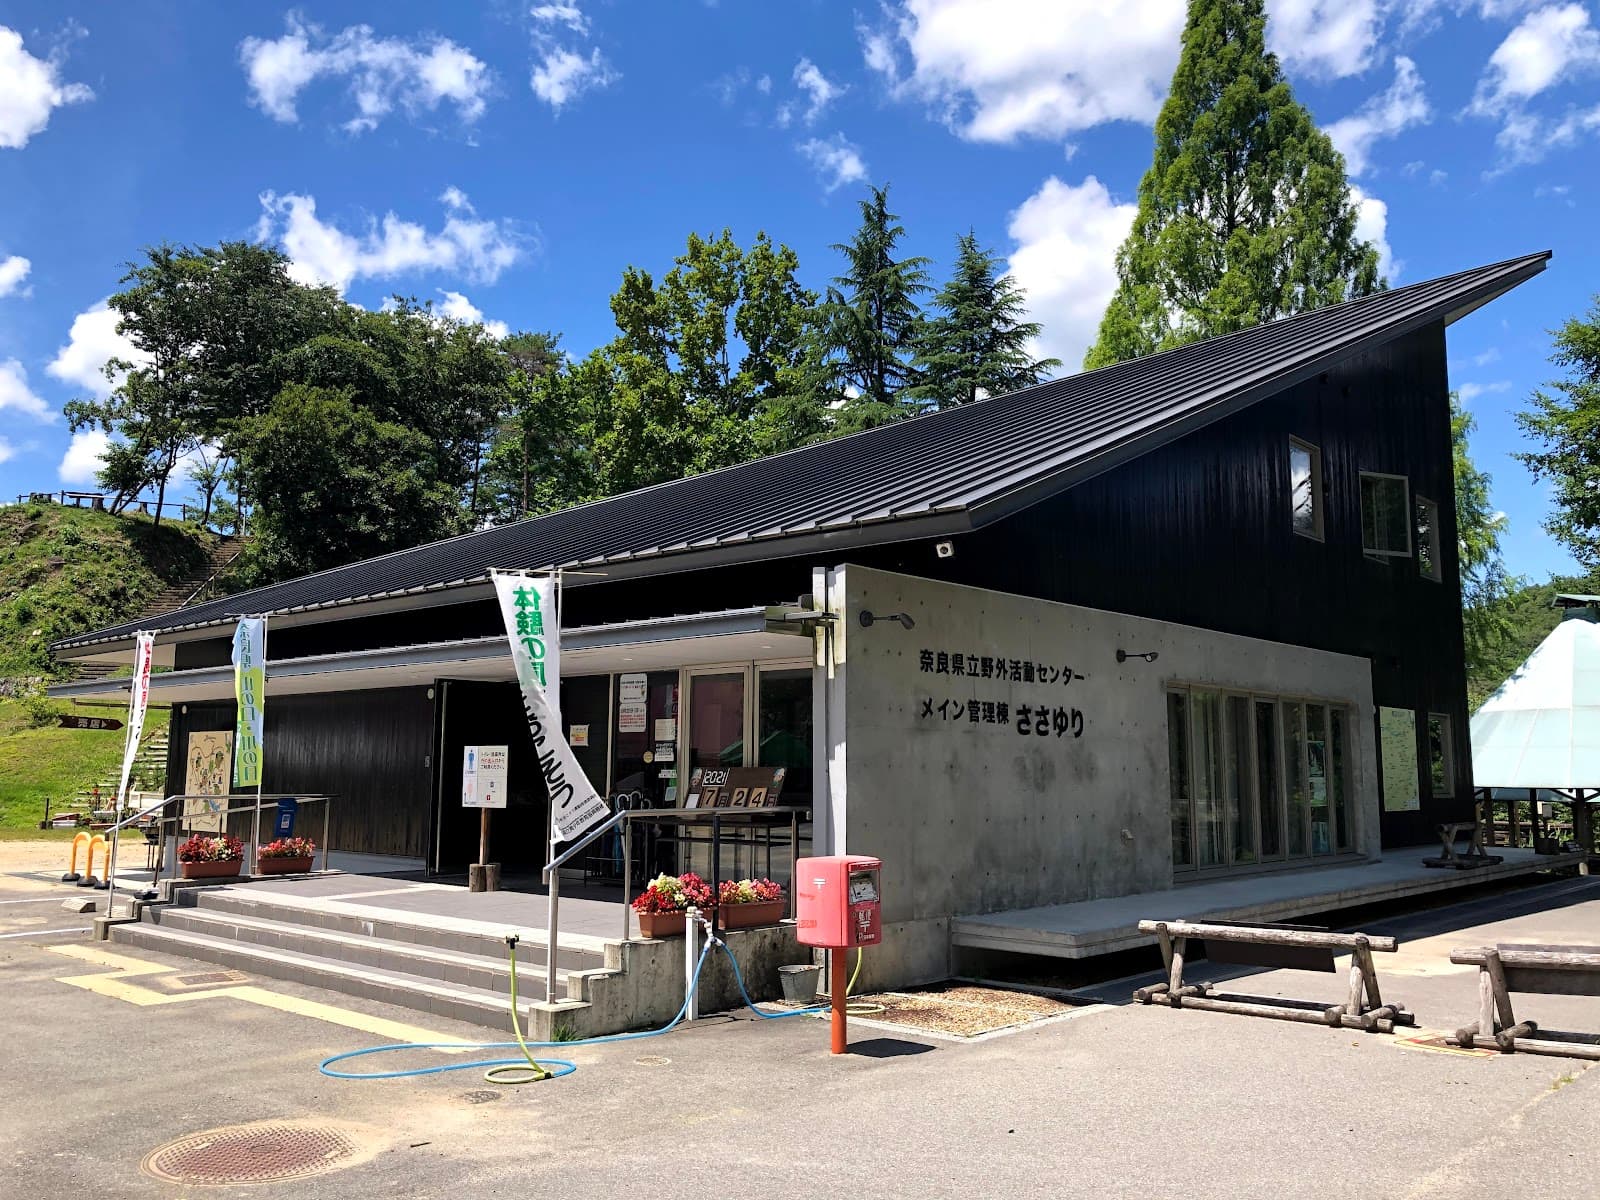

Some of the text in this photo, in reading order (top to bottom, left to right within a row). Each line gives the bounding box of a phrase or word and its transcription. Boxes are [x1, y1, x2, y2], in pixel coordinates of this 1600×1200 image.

[920, 649, 1085, 686] 奈良県立野外活動センター
[921, 698, 1084, 739] メイン管理棟 ささゆり
[704, 770, 727, 784] 2021
